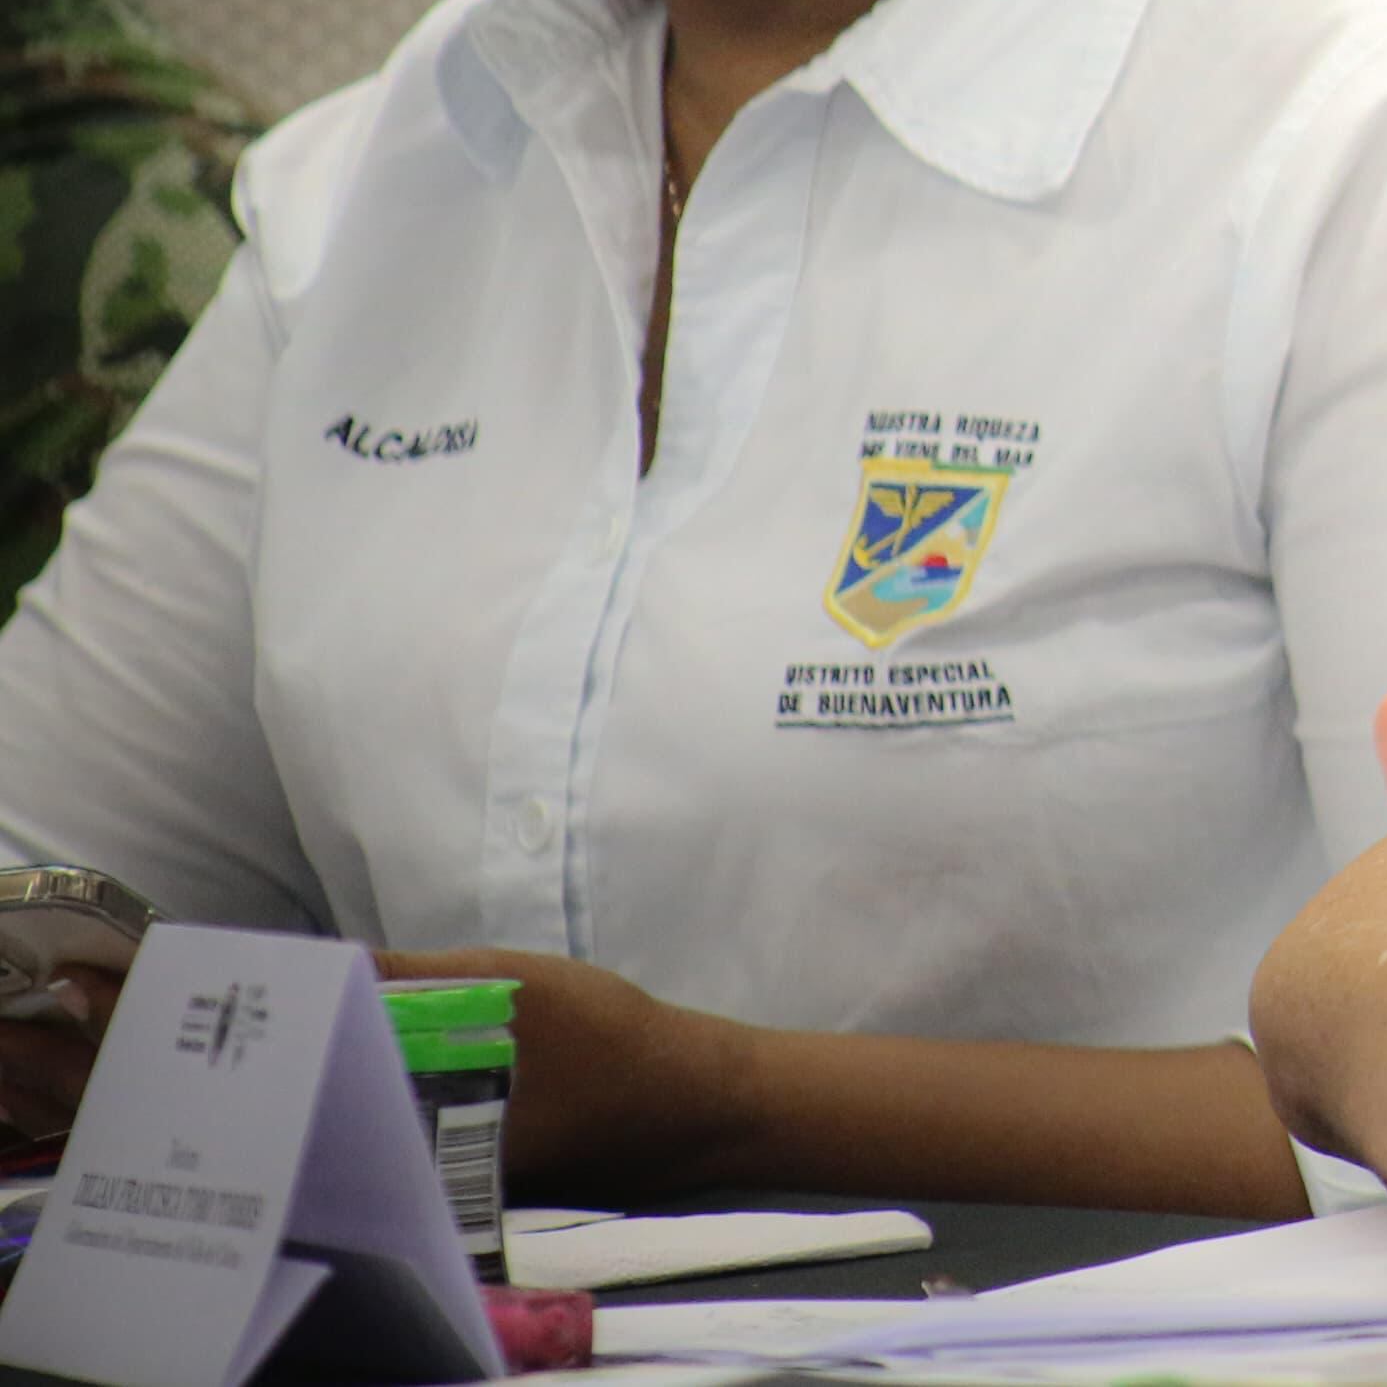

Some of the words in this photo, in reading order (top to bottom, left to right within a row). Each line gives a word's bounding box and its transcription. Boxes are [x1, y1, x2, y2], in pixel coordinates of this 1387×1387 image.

[956, 414, 1040, 442] RIQUEZA
[785, 662, 875, 686] DISTRITO
[888, 659, 993, 686] ESPECIAL
[777, 691, 802, 714] DE
[817, 685, 1011, 716] BUENAVENTURA
